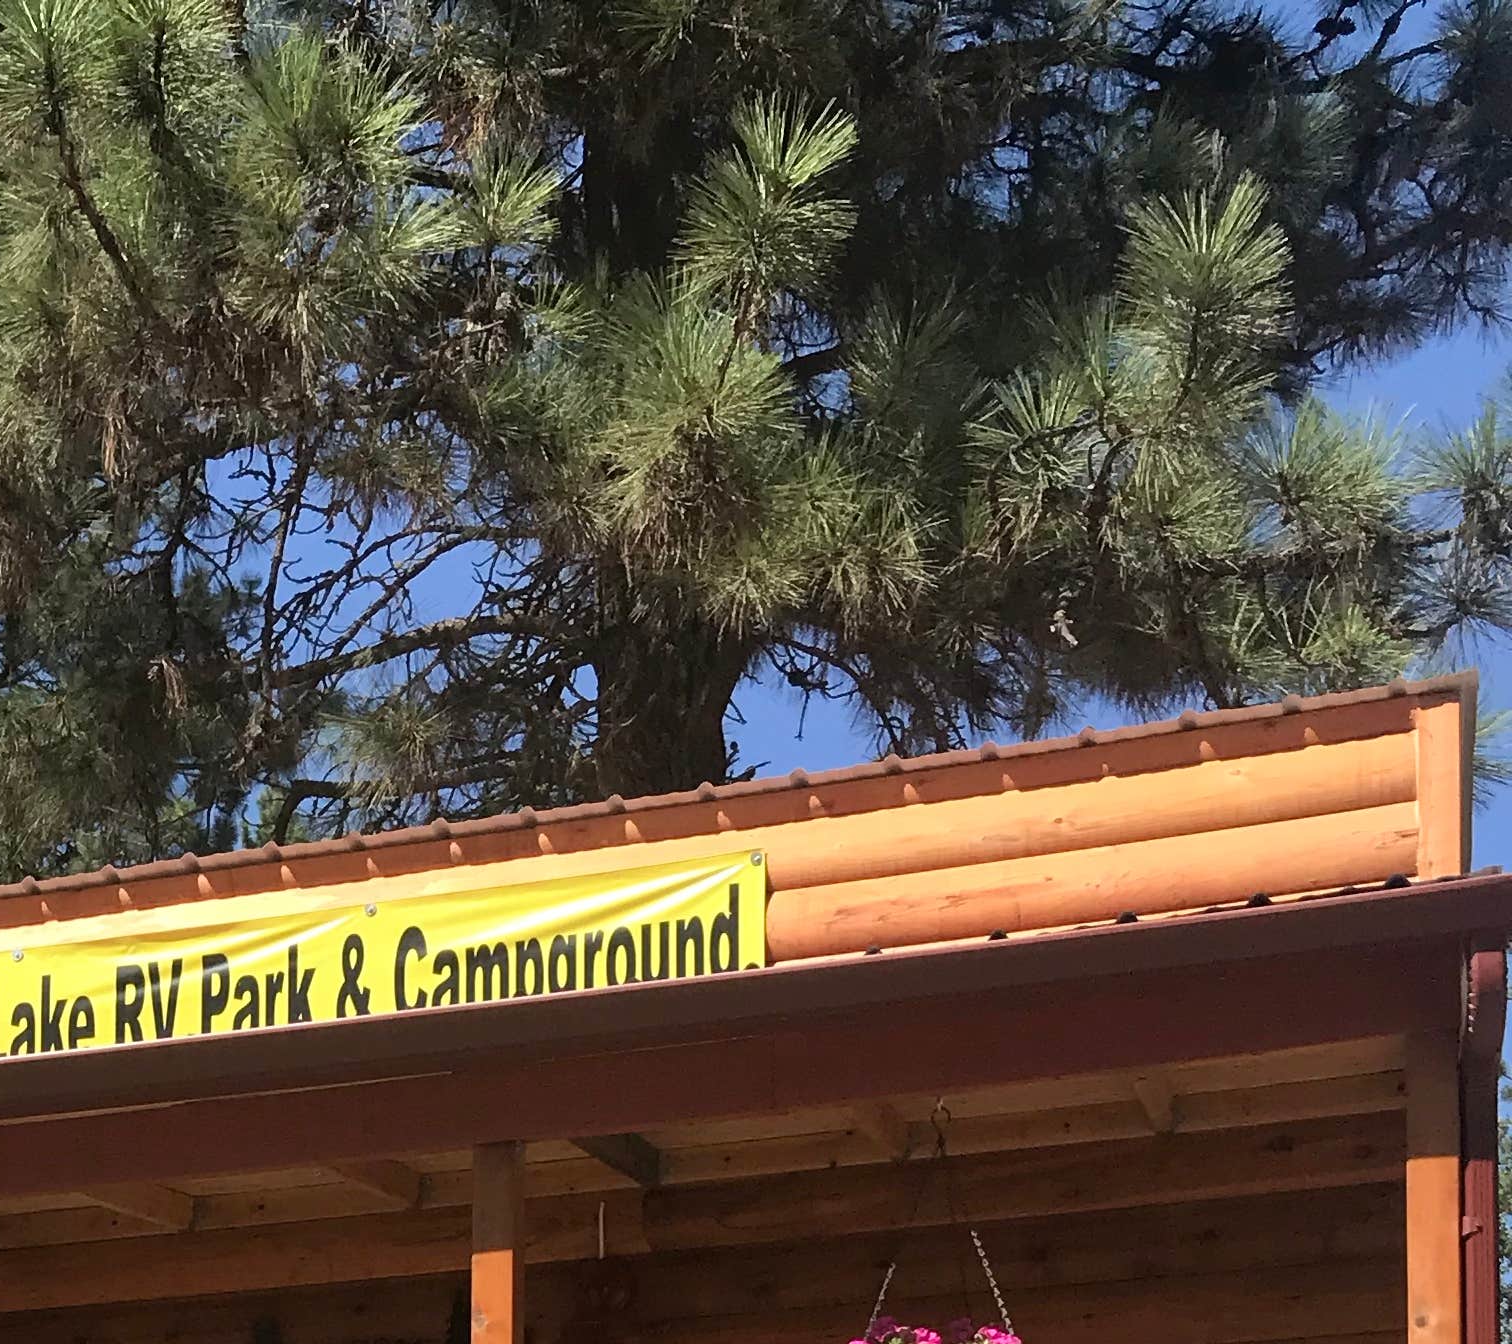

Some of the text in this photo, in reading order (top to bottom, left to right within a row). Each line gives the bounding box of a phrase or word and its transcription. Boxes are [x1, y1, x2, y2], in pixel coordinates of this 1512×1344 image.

[115, 958, 183, 1045] RV
[202, 945, 316, 1034] Park
[336, 933, 372, 1018] &
